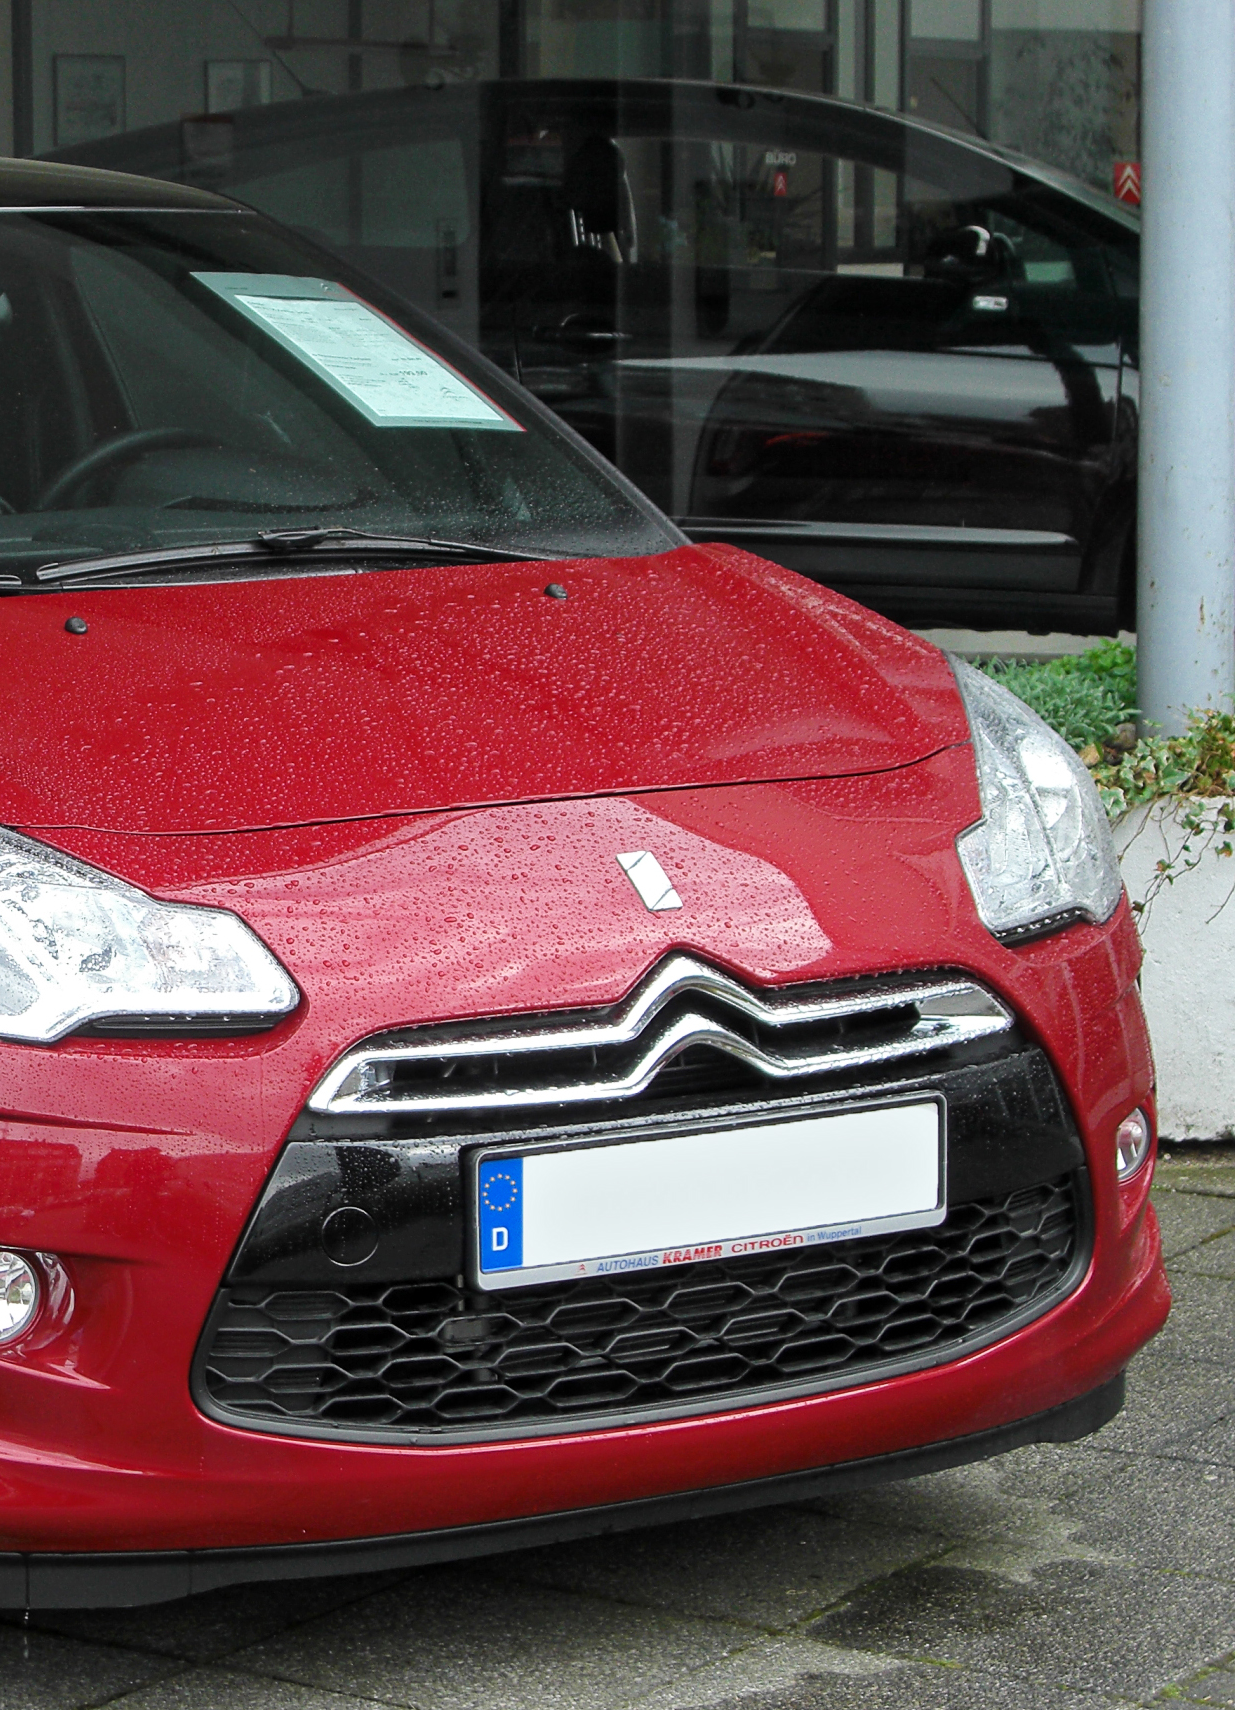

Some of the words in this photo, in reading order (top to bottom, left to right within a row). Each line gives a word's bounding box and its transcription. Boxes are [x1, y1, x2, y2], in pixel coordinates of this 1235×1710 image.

[492, 1226, 508, 1251] D
[596, 1255, 659, 1273] AUTOHAUS
[662, 1244, 723, 1265] KRAMER
[807, 1233, 816, 1242] in
[817, 1226, 862, 1241] Wuppertal
